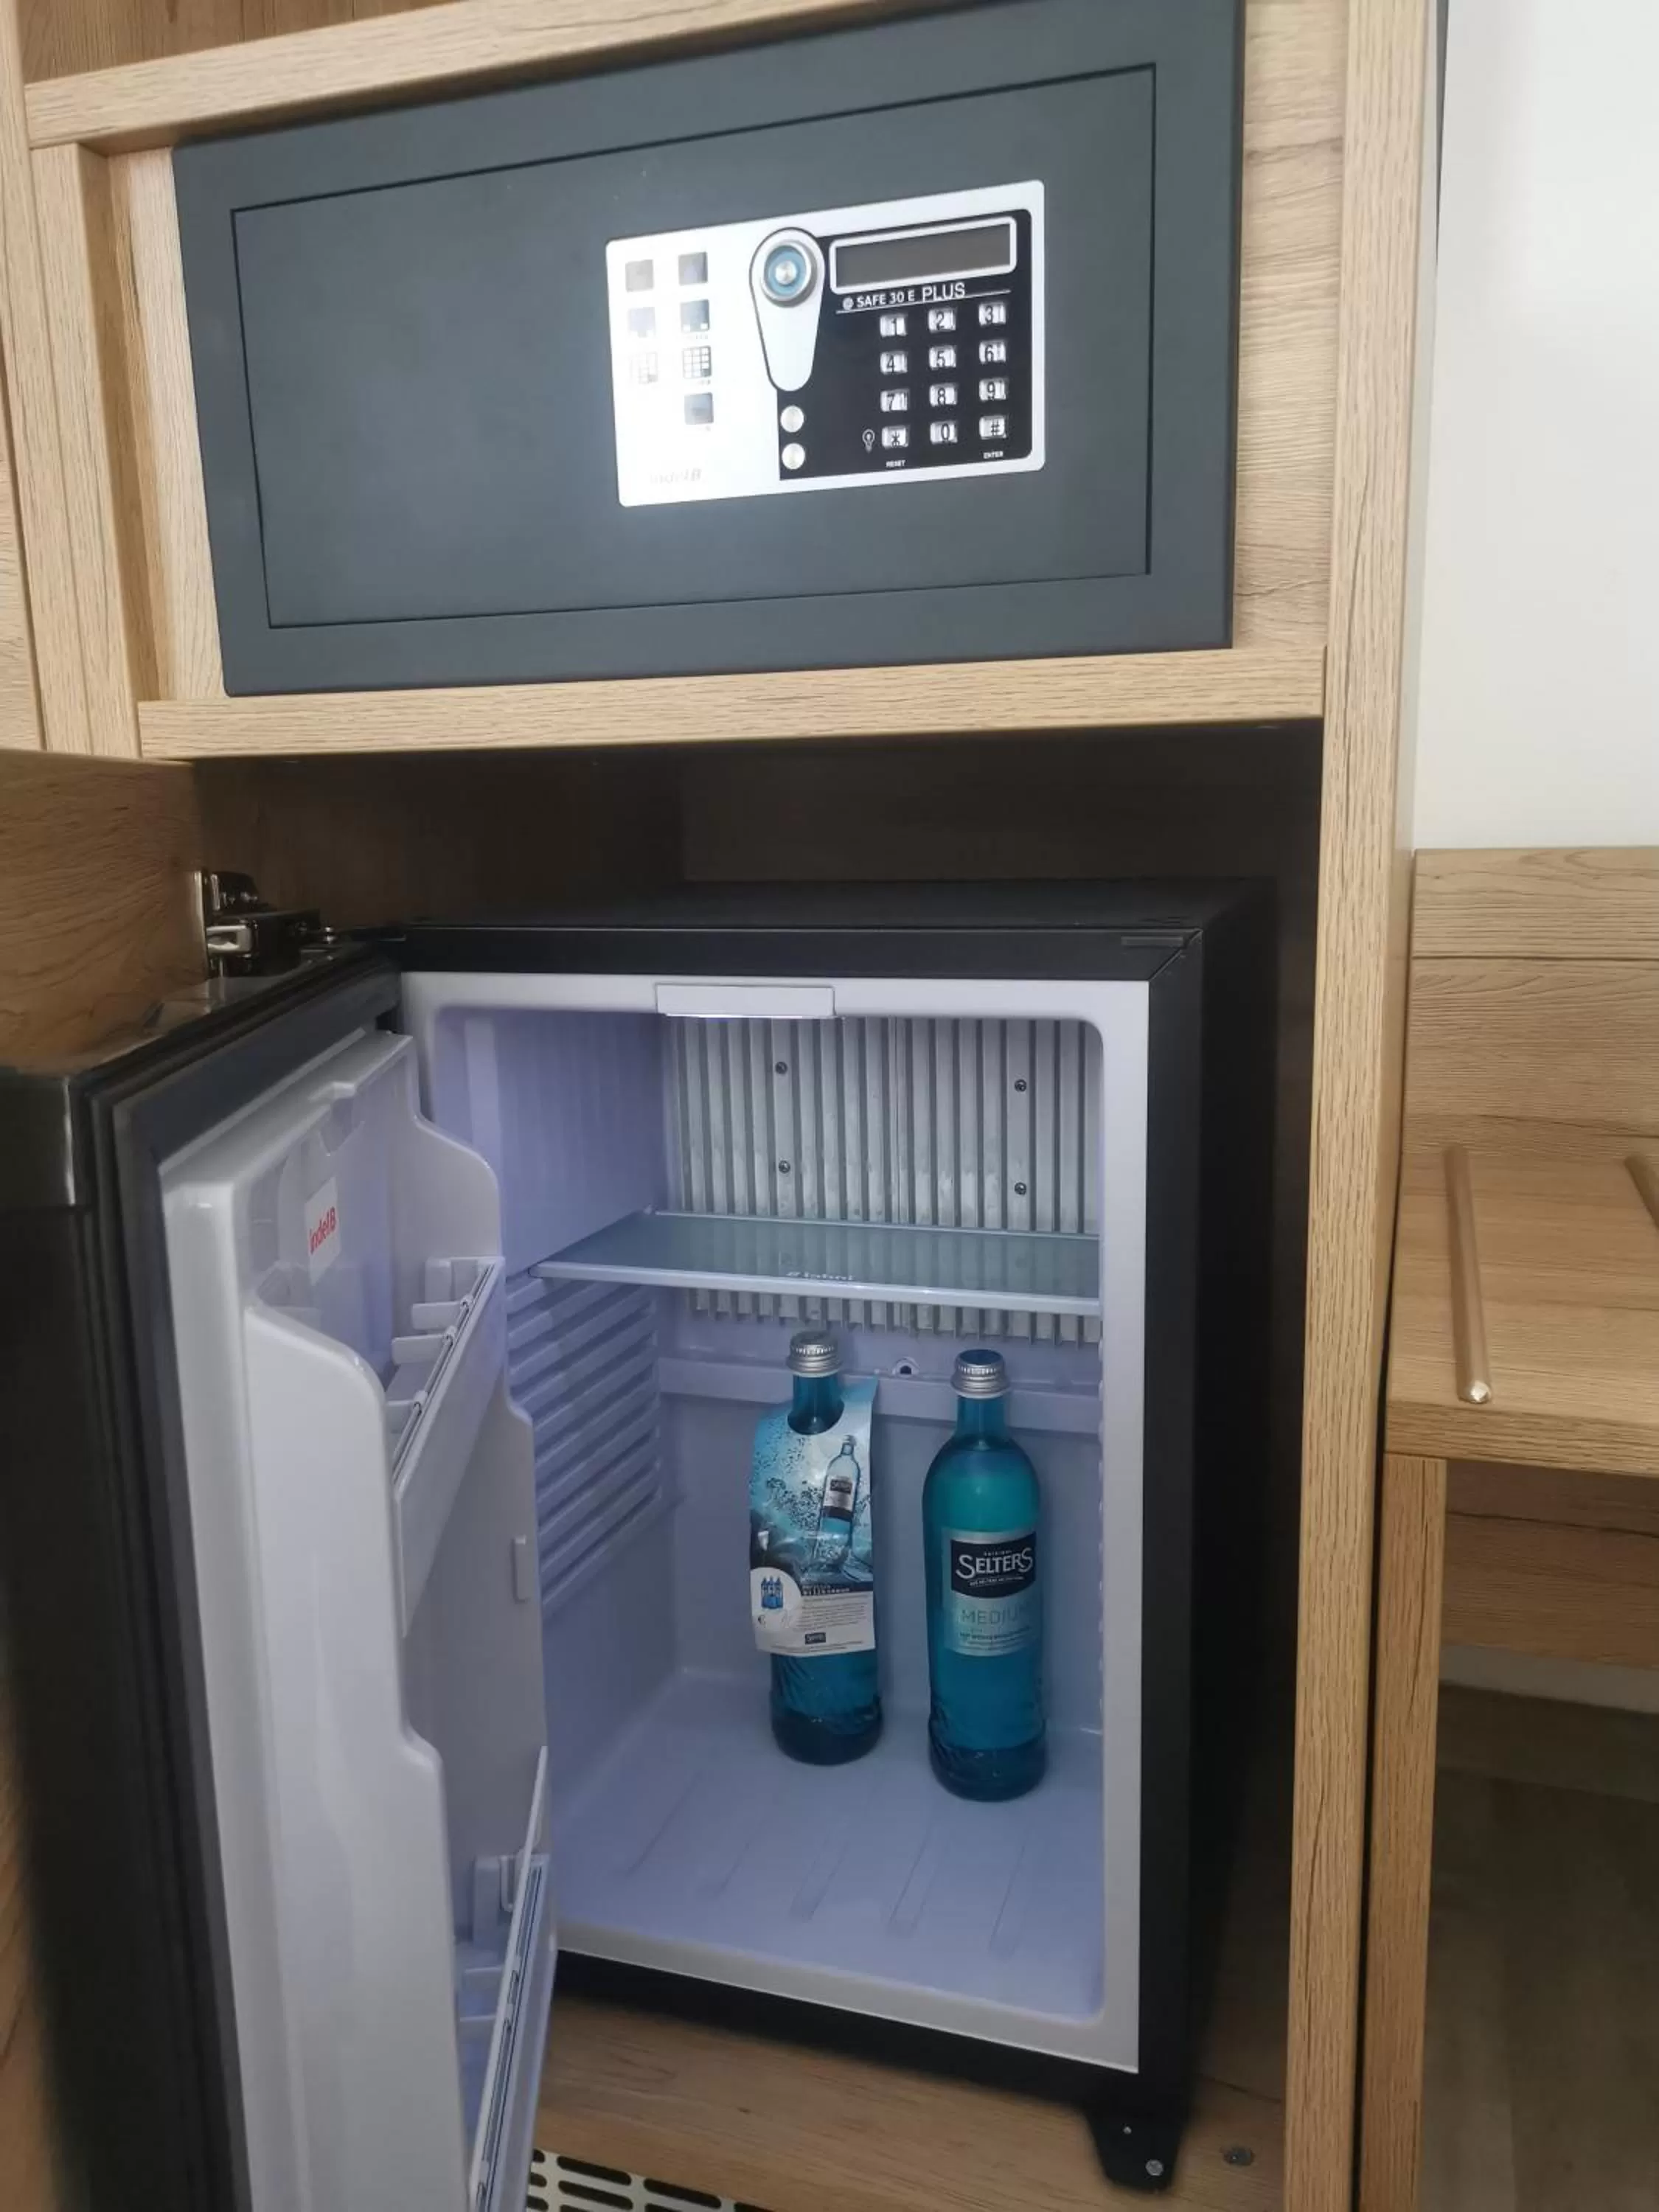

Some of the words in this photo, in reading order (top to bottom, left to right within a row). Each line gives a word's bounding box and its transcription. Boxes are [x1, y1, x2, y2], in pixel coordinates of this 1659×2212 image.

[856, 294, 886, 308] SAFE
[888, 293, 904, 305] 30
[908, 290, 916, 302] E
[922, 282, 966, 304] PLUS
[886, 459, 906, 468] RESET
[983, 451, 1004, 459] ENTER
[956, 1548, 1034, 1579] SELTERS
